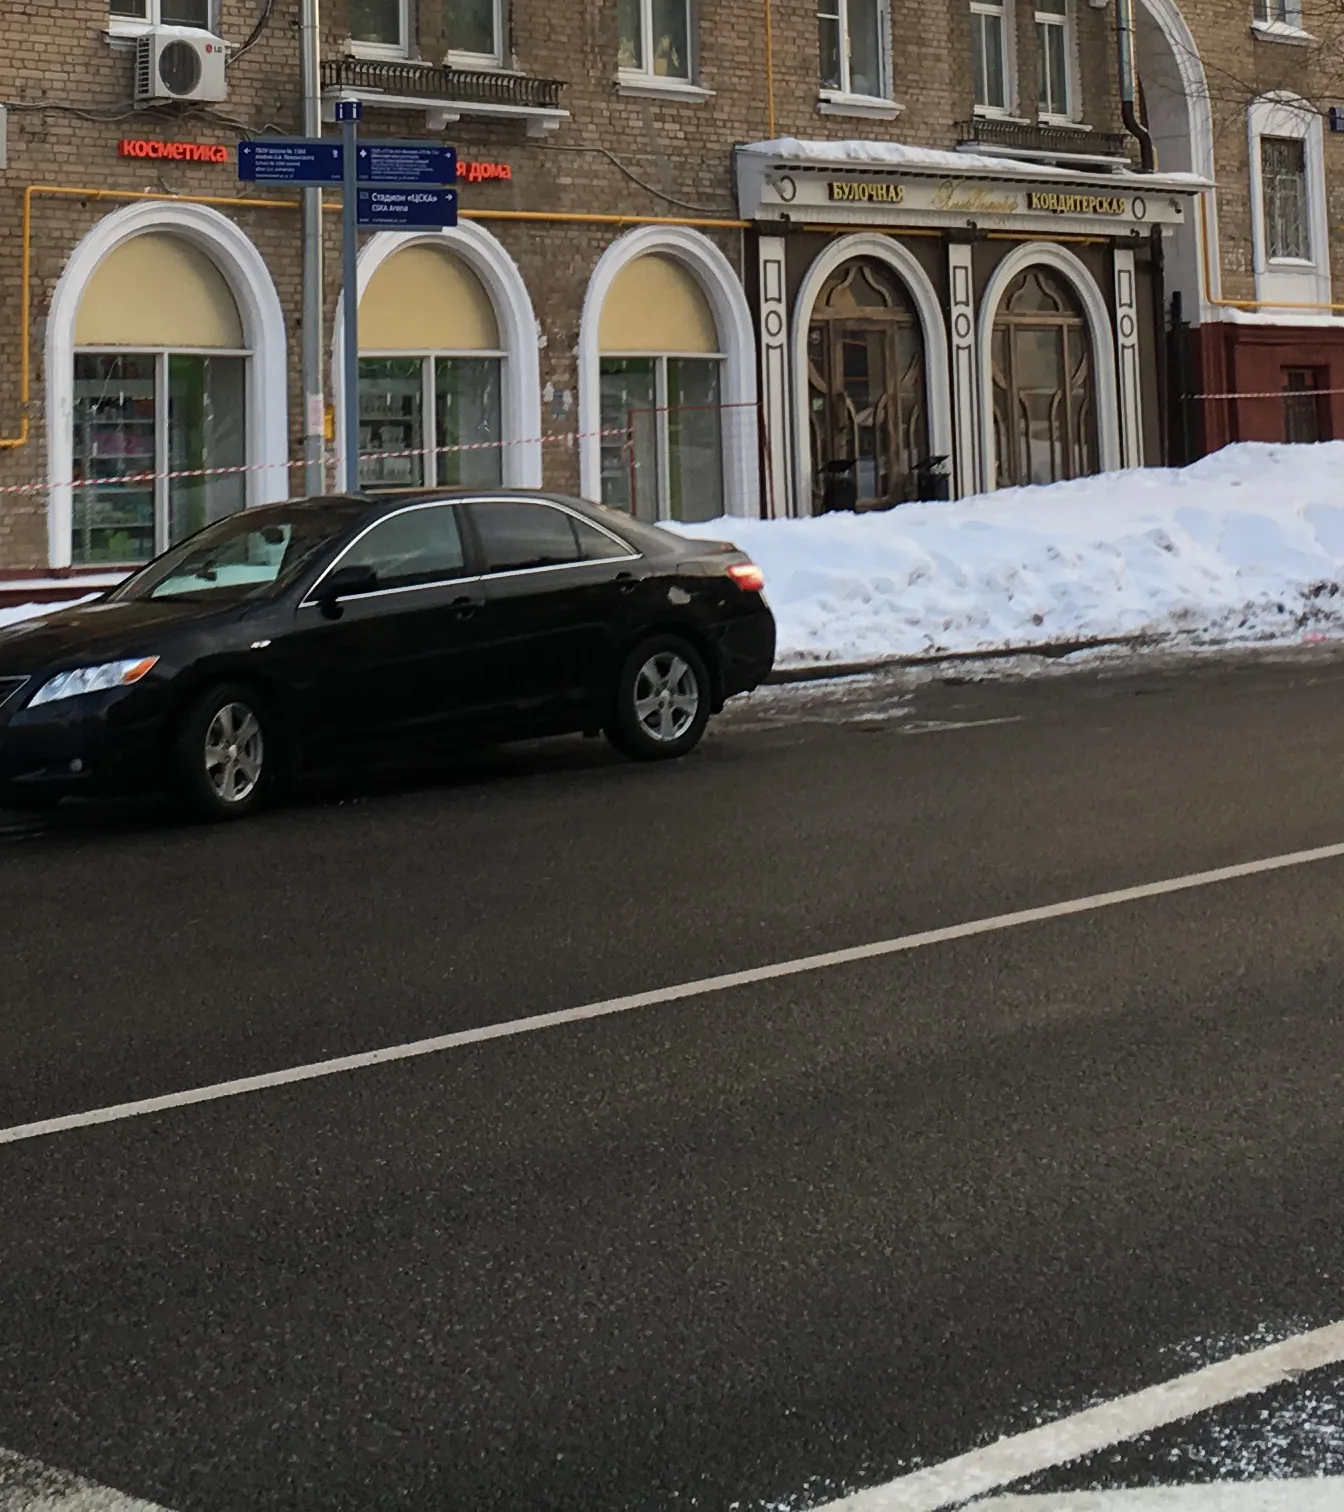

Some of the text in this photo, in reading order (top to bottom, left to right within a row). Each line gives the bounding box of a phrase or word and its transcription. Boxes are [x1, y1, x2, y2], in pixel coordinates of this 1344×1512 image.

[213, 46, 223, 54] LG
[119, 139, 228, 163] косметика
[467, 161, 513, 183] дома
[371, 192, 438, 204] Стадион «ЦСКА»
[831, 182, 906, 202] БУЛОЧНАЯ
[1030, 192, 1127, 215] КОНДИТЕРСКАЯ
